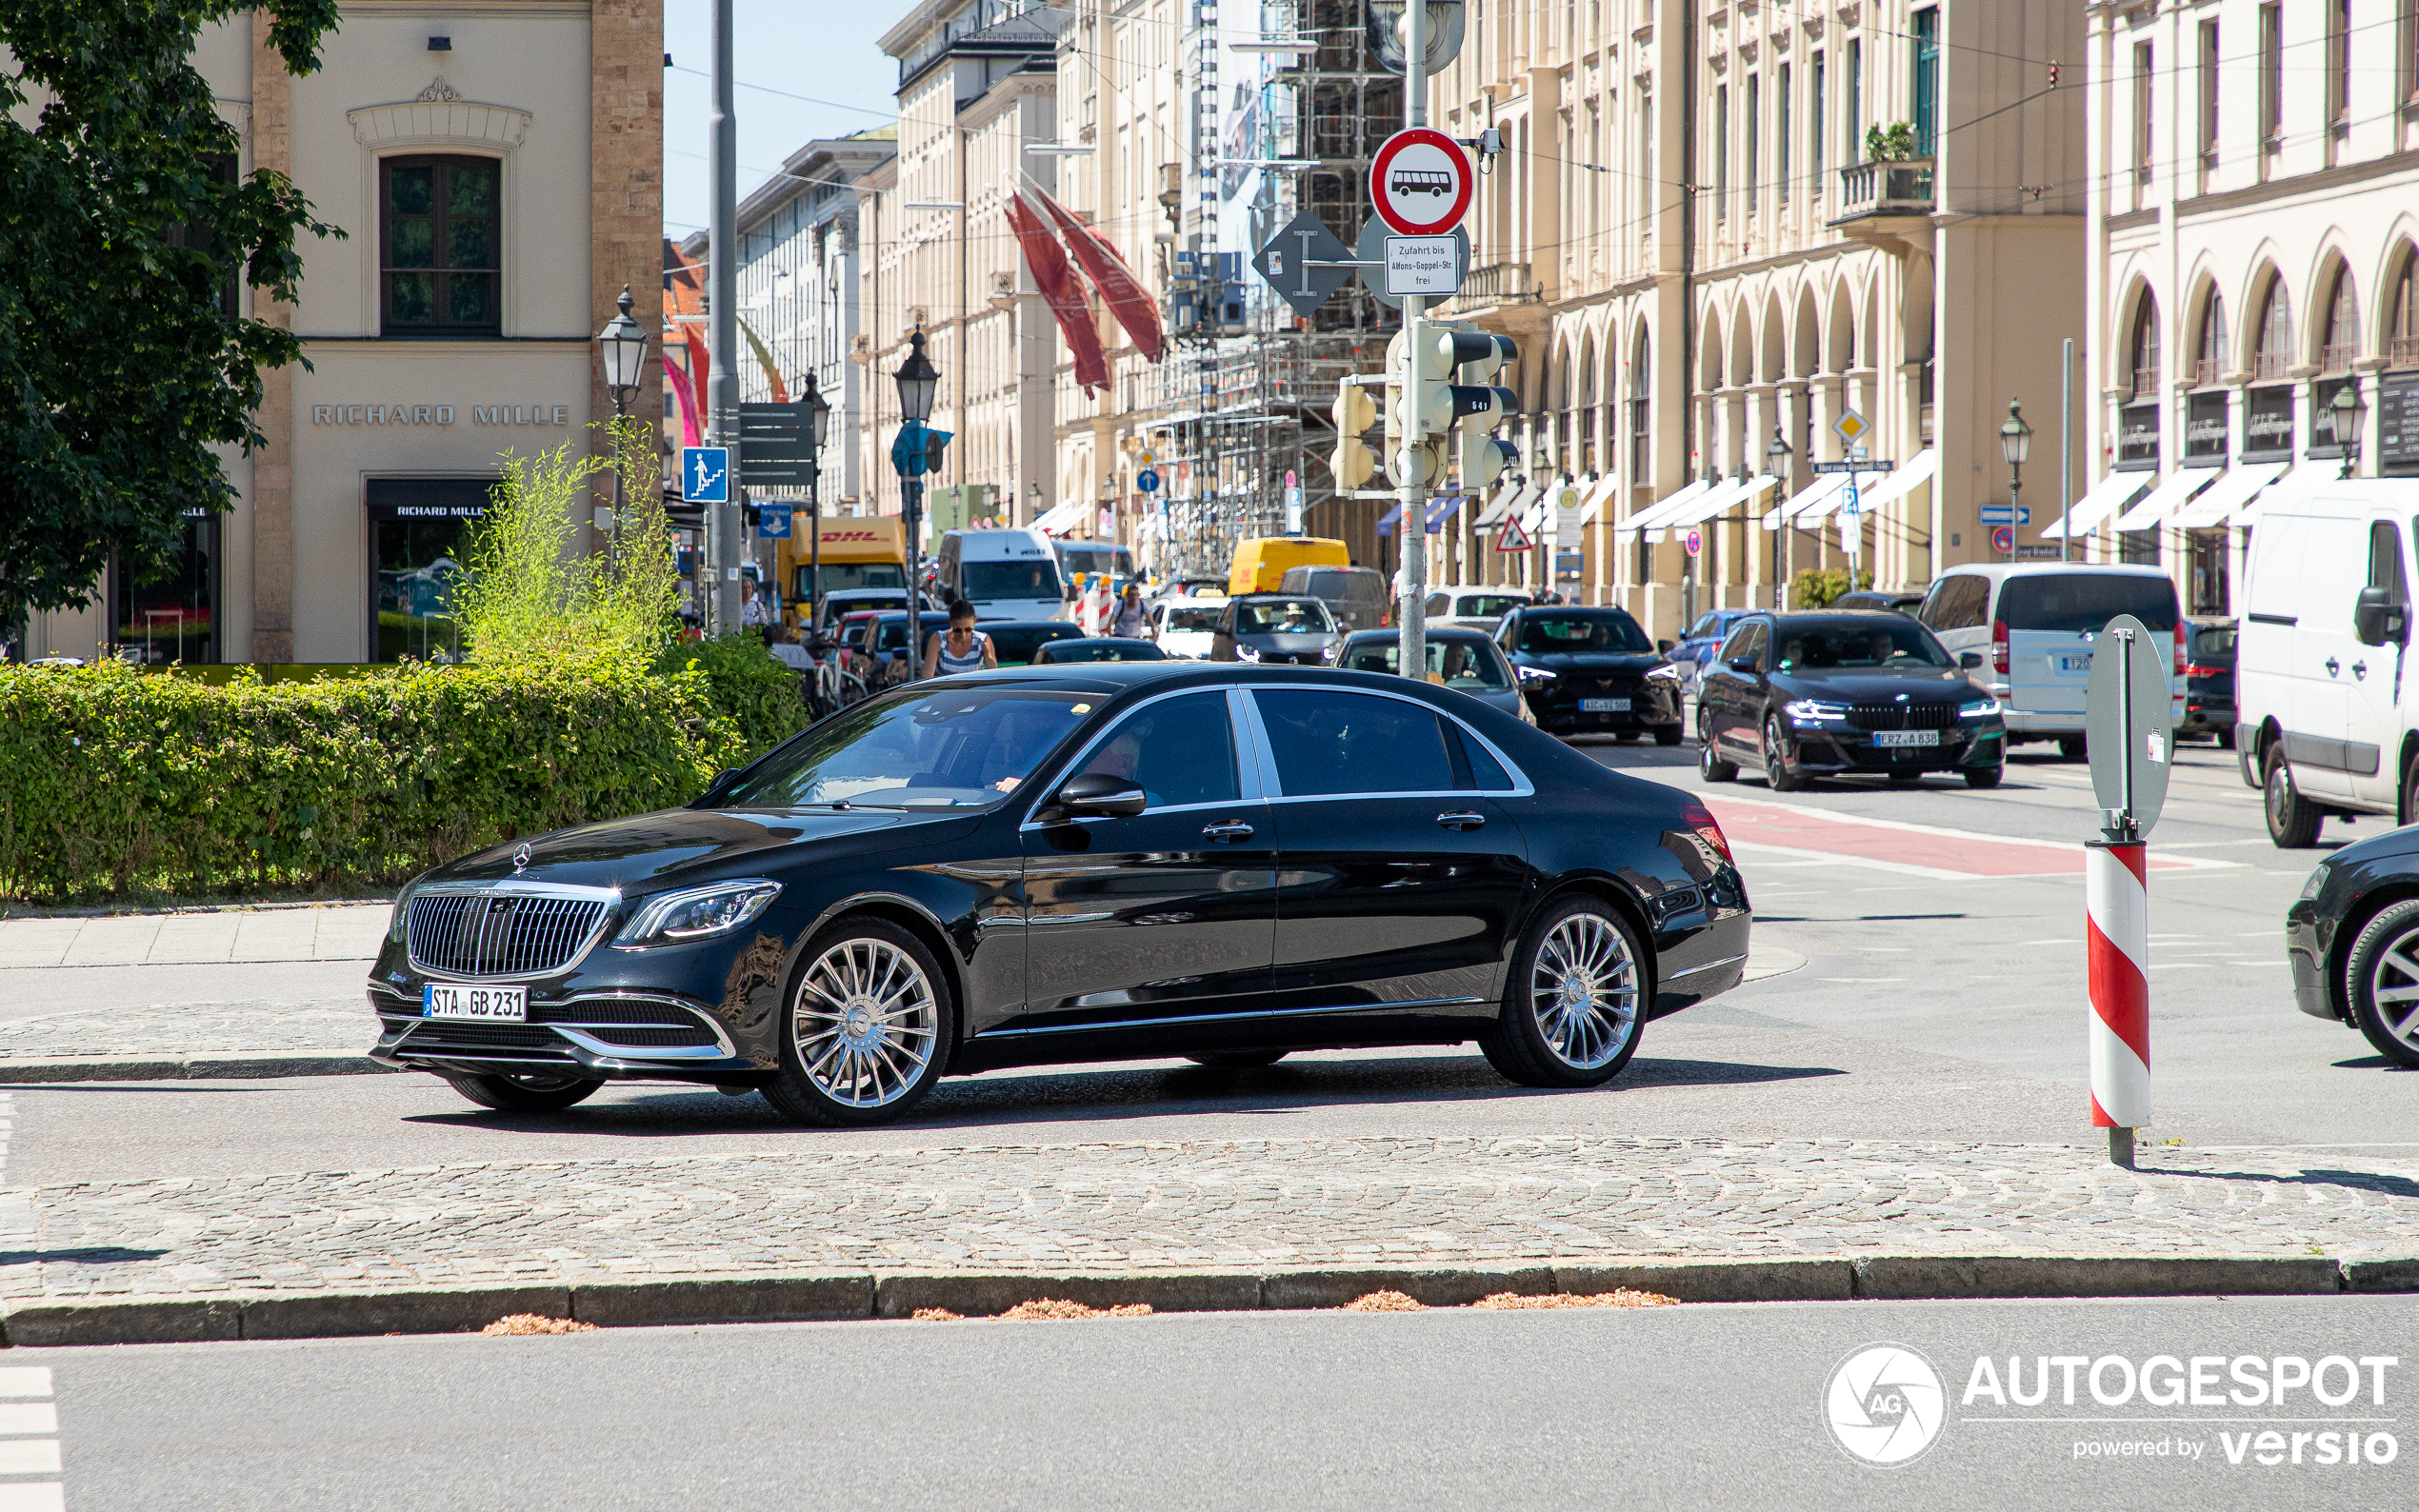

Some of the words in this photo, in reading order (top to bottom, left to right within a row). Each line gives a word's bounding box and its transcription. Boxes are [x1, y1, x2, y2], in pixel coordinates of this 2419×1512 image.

[1399, 246, 1430, 255] Zufahrt
[1432, 245, 1445, 254] bis
[1391, 261, 1453, 271] Alfons-Goppel-Str.
[1415, 276, 1430, 285] frei
[1471, 401, 1488, 410] 541
[313, 405, 454, 425] RICHARD
[473, 405, 569, 426] MILLE
[397, 507, 447, 516] RICHARD
[450, 507, 484, 516] MILLE
[821, 531, 877, 542] DHL
[2070, 659, 2091, 670] 120
[1881, 733, 1902, 745] ERZ
[1909, 733, 1916, 744] A
[432, 988, 458, 1014] STA
[470, 990, 490, 1015] GB
[493, 991, 523, 1017] 231
